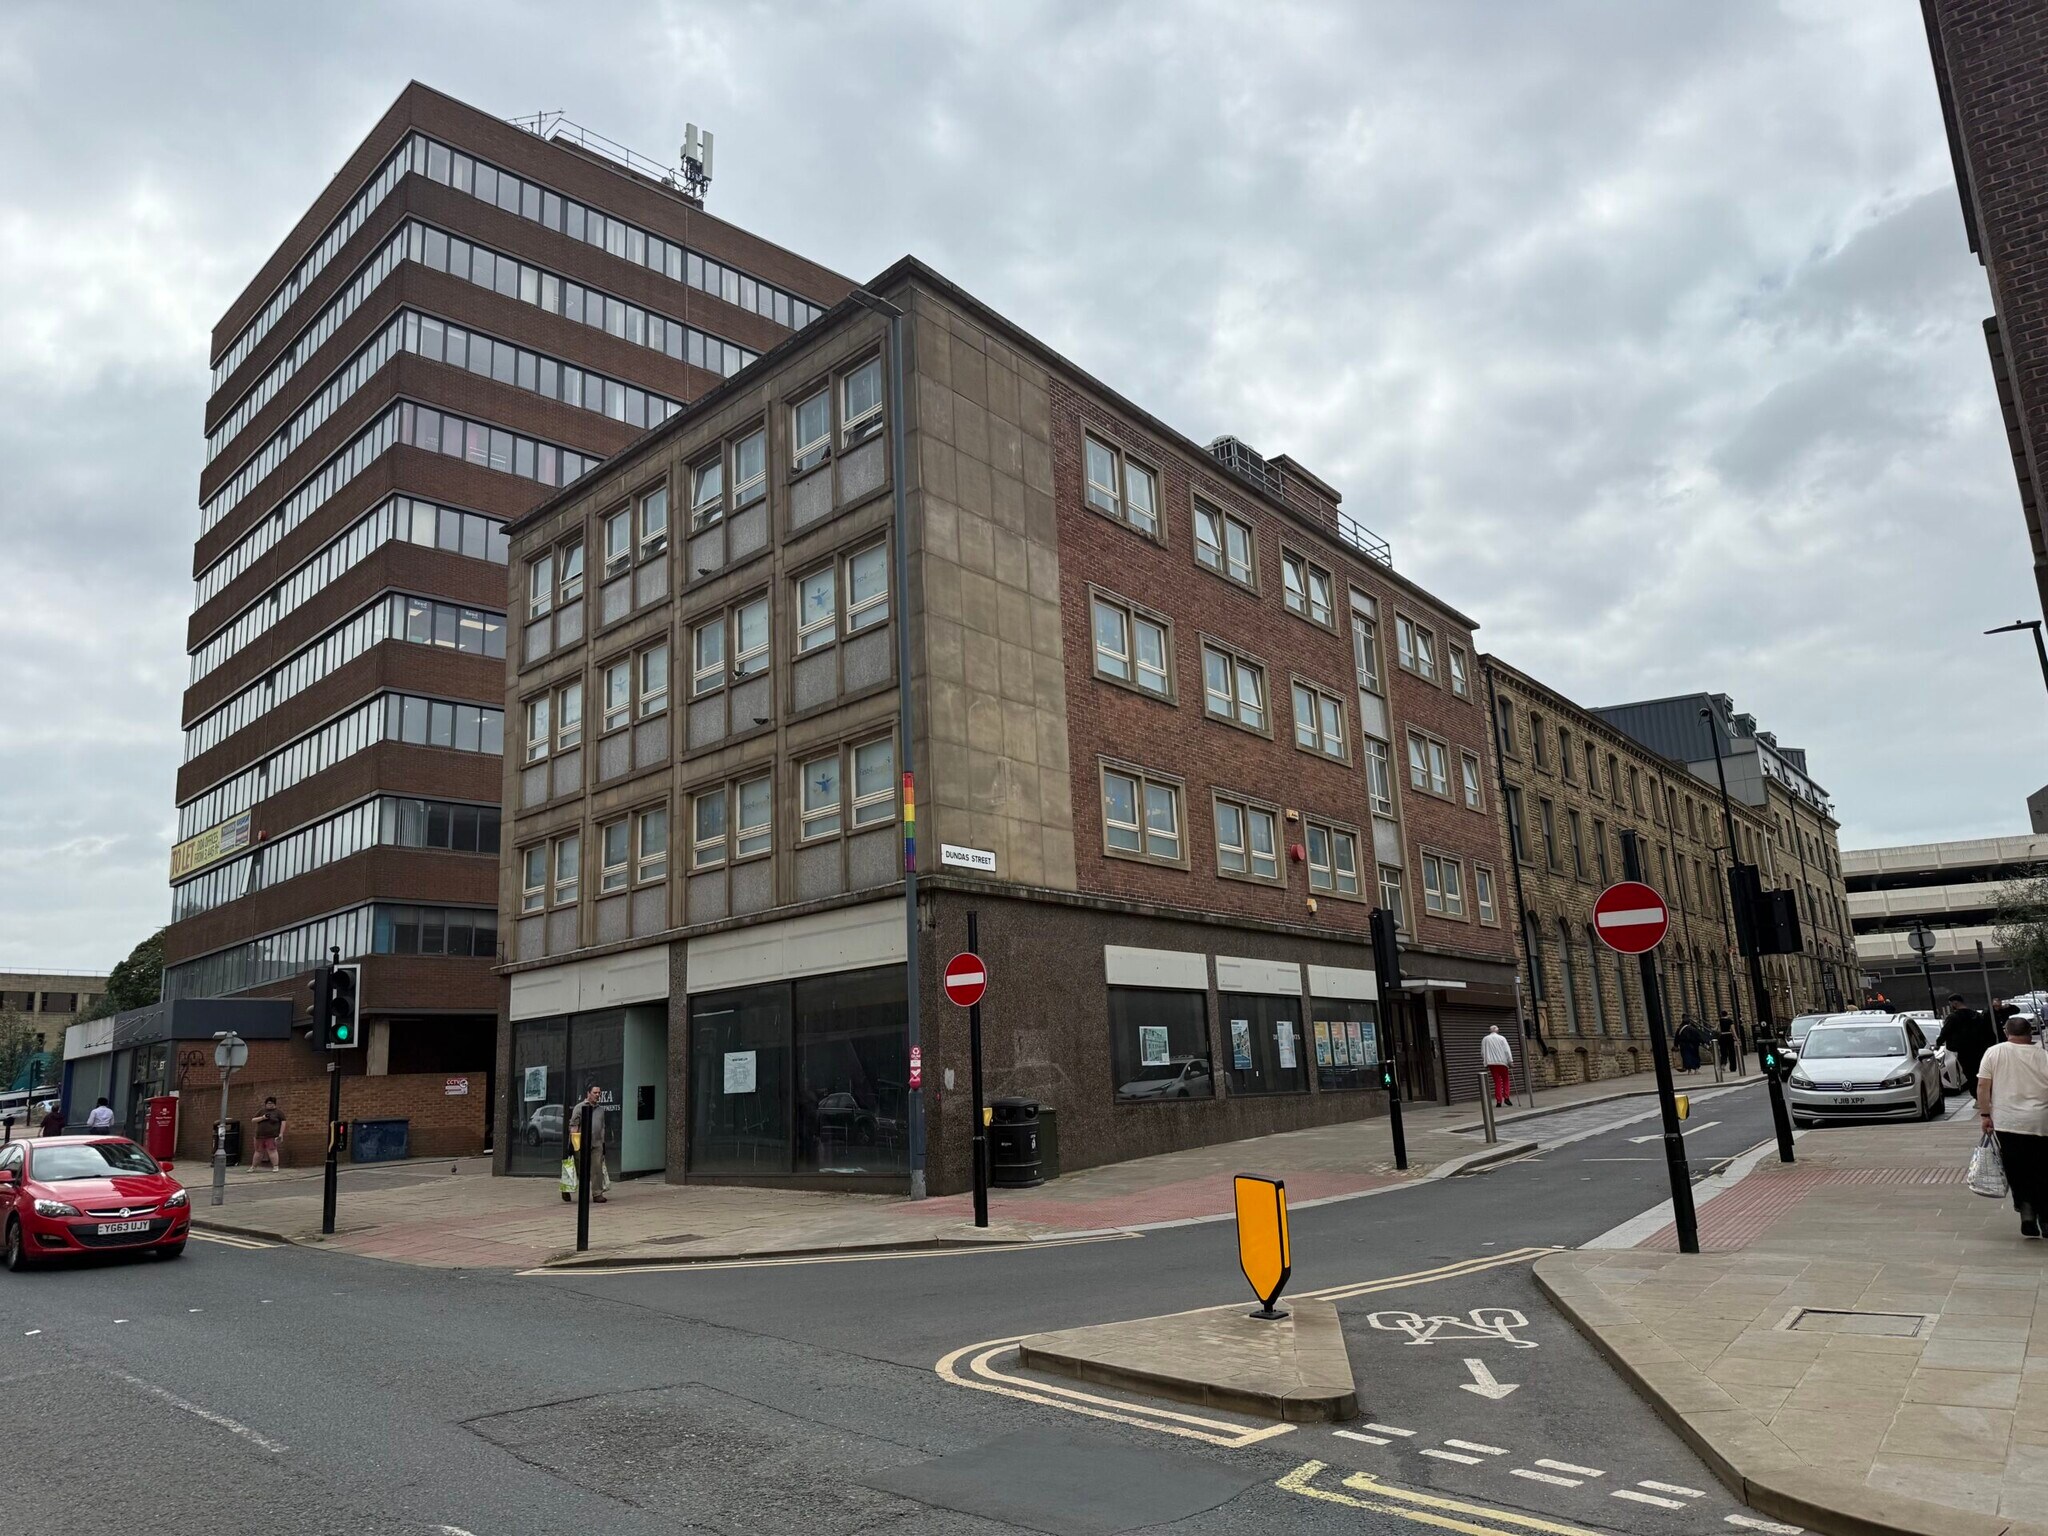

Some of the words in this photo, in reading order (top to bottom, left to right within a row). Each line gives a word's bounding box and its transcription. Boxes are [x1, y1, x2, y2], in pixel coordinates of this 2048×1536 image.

[172, 847, 181, 877] TO
[181, 841, 196, 872] LET
[945, 850, 970, 862] DUNDAS
[971, 855, 992, 865] STREET
[105, 1223, 129, 1233] YG63
[130, 1221, 148, 1231] UJY
